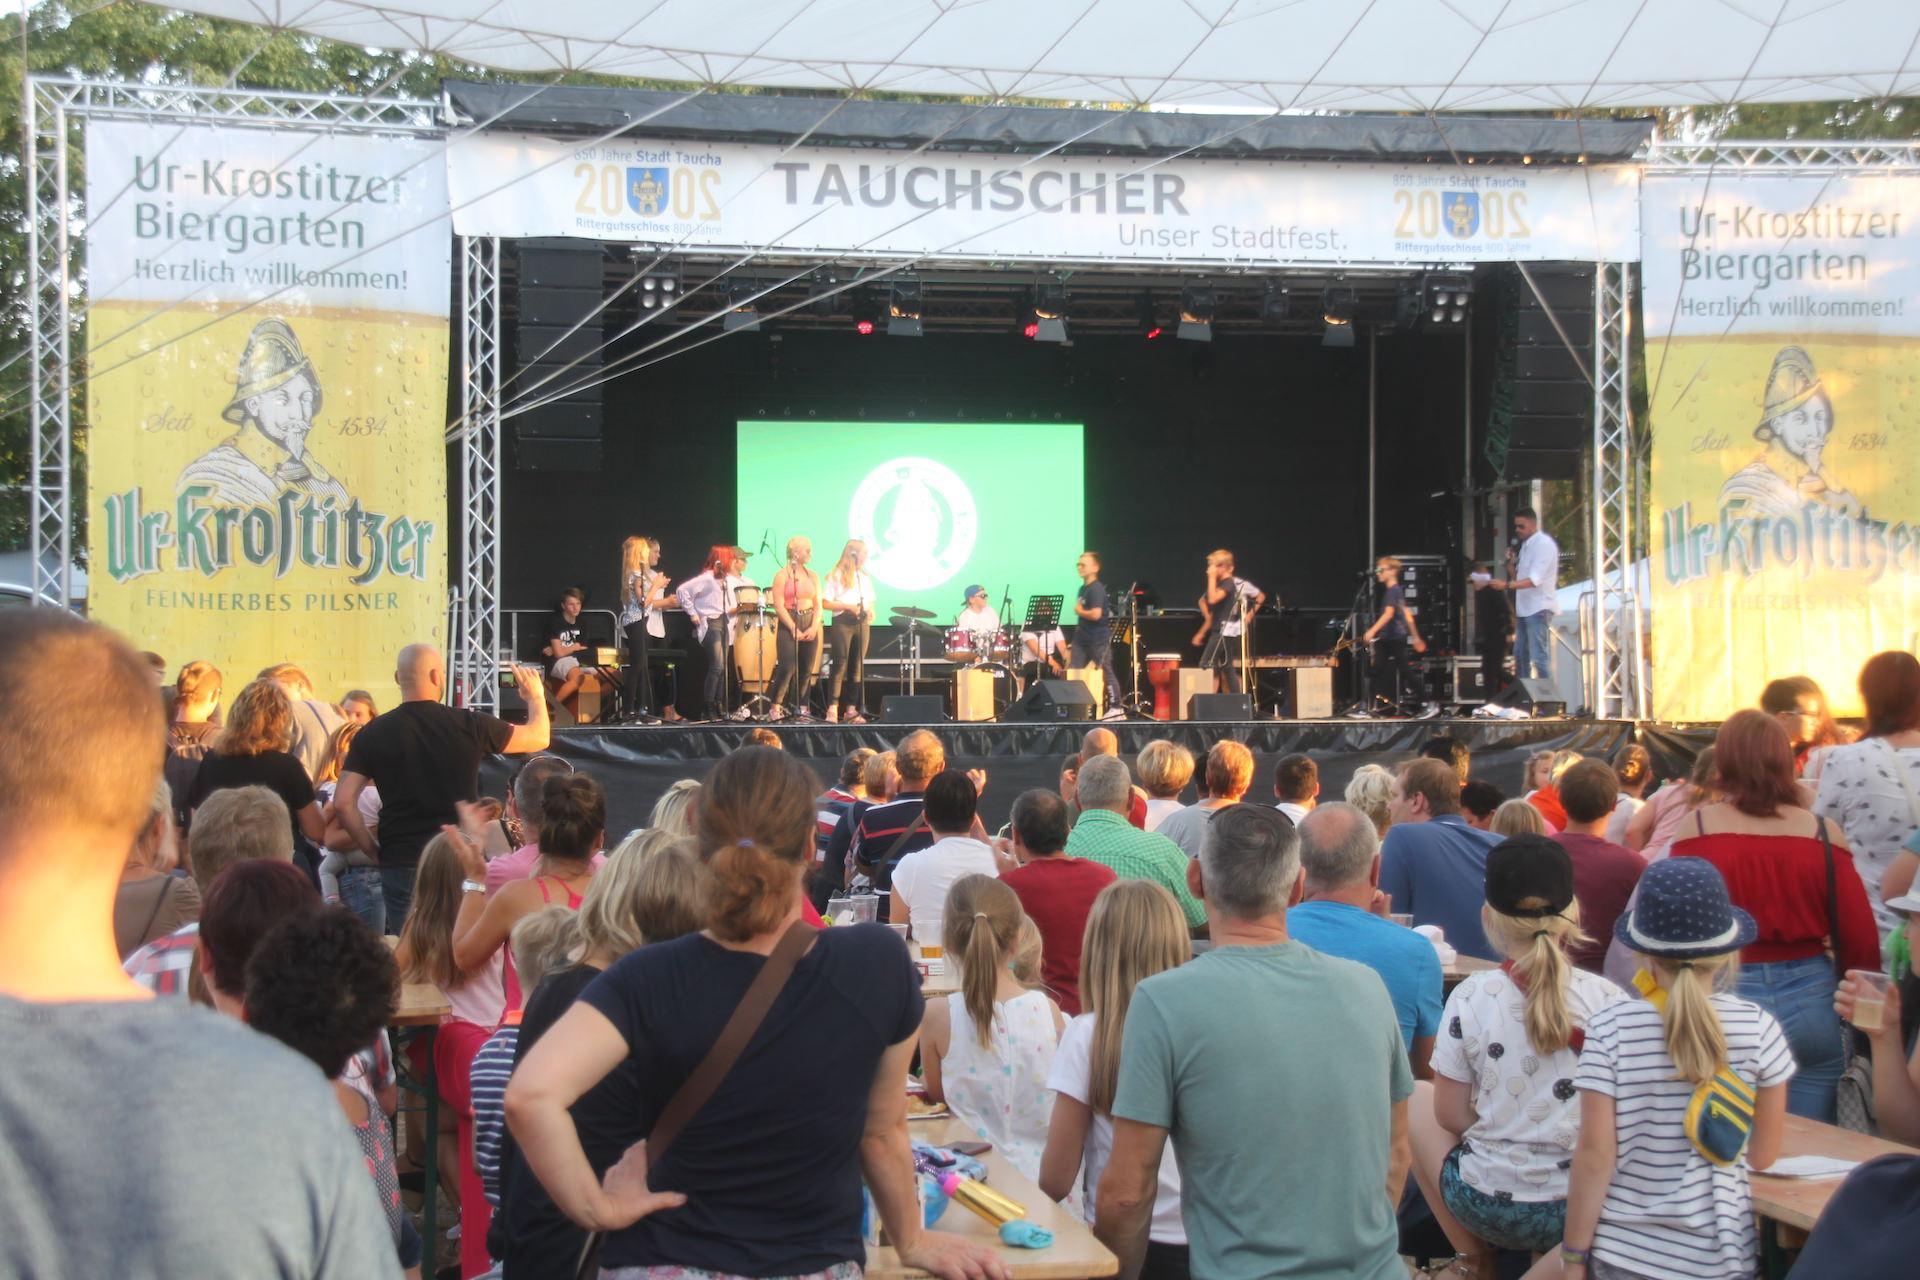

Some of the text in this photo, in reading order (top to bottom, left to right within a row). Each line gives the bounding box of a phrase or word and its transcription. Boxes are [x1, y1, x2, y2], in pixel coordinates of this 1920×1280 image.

[600, 148, 633, 163] Jahre
[636, 150, 671, 164] Stadt
[676, 151, 722, 166] Taucha
[134, 155, 407, 204] Ur-Krostitzer
[773, 162, 1190, 216] TAUCHSCHER
[1416, 174, 1447, 187] Jahre
[1449, 175, 1481, 188] Stadt
[1485, 176, 1527, 189] Taucha
[135, 202, 364, 254] Biergarten
[576, 217, 670, 234] Rittergutsschloss
[1679, 205, 1901, 239] Ur-Krostitzer
[1118, 223, 1348, 250] Unser Stadtfest.
[1394, 241, 1483, 255] Rittergutsschloss
[134, 259, 408, 290] Herzlich willkommen!
[1681, 246, 1867, 289] Biergarten
[1680, 296, 1904, 317] Herzlich willkommen!
[145, 407, 388, 437] Seit 1534
[146, 589, 400, 612] FEINHERBES PILSNER
